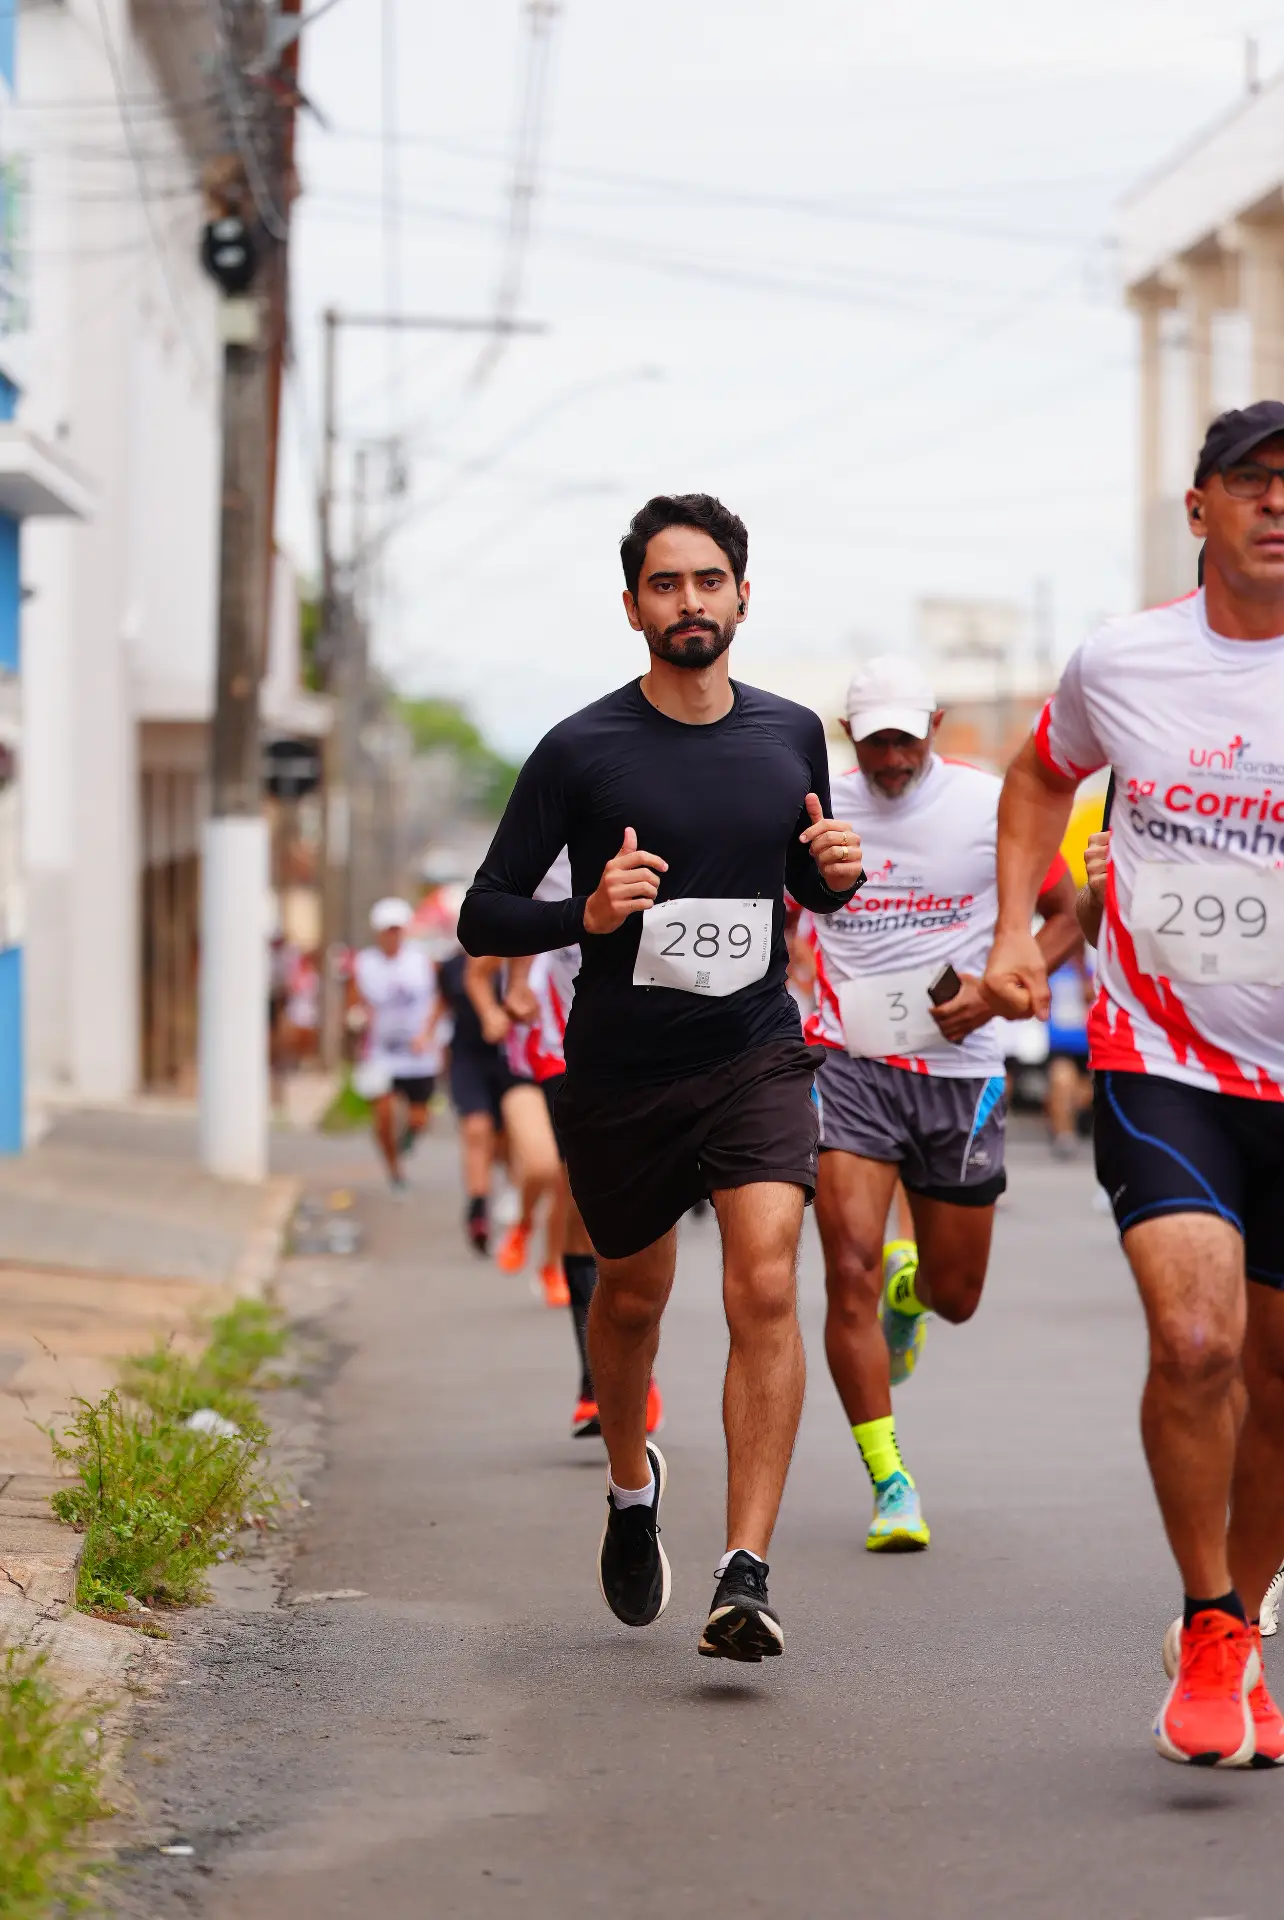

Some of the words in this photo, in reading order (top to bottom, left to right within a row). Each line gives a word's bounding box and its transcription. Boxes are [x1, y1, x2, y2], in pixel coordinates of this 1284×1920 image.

[1130, 808, 1284, 855] Caminh
[1156, 893, 1267, 938] 299
[660, 921, 752, 958] 289
[886, 992, 908, 1021] 3
